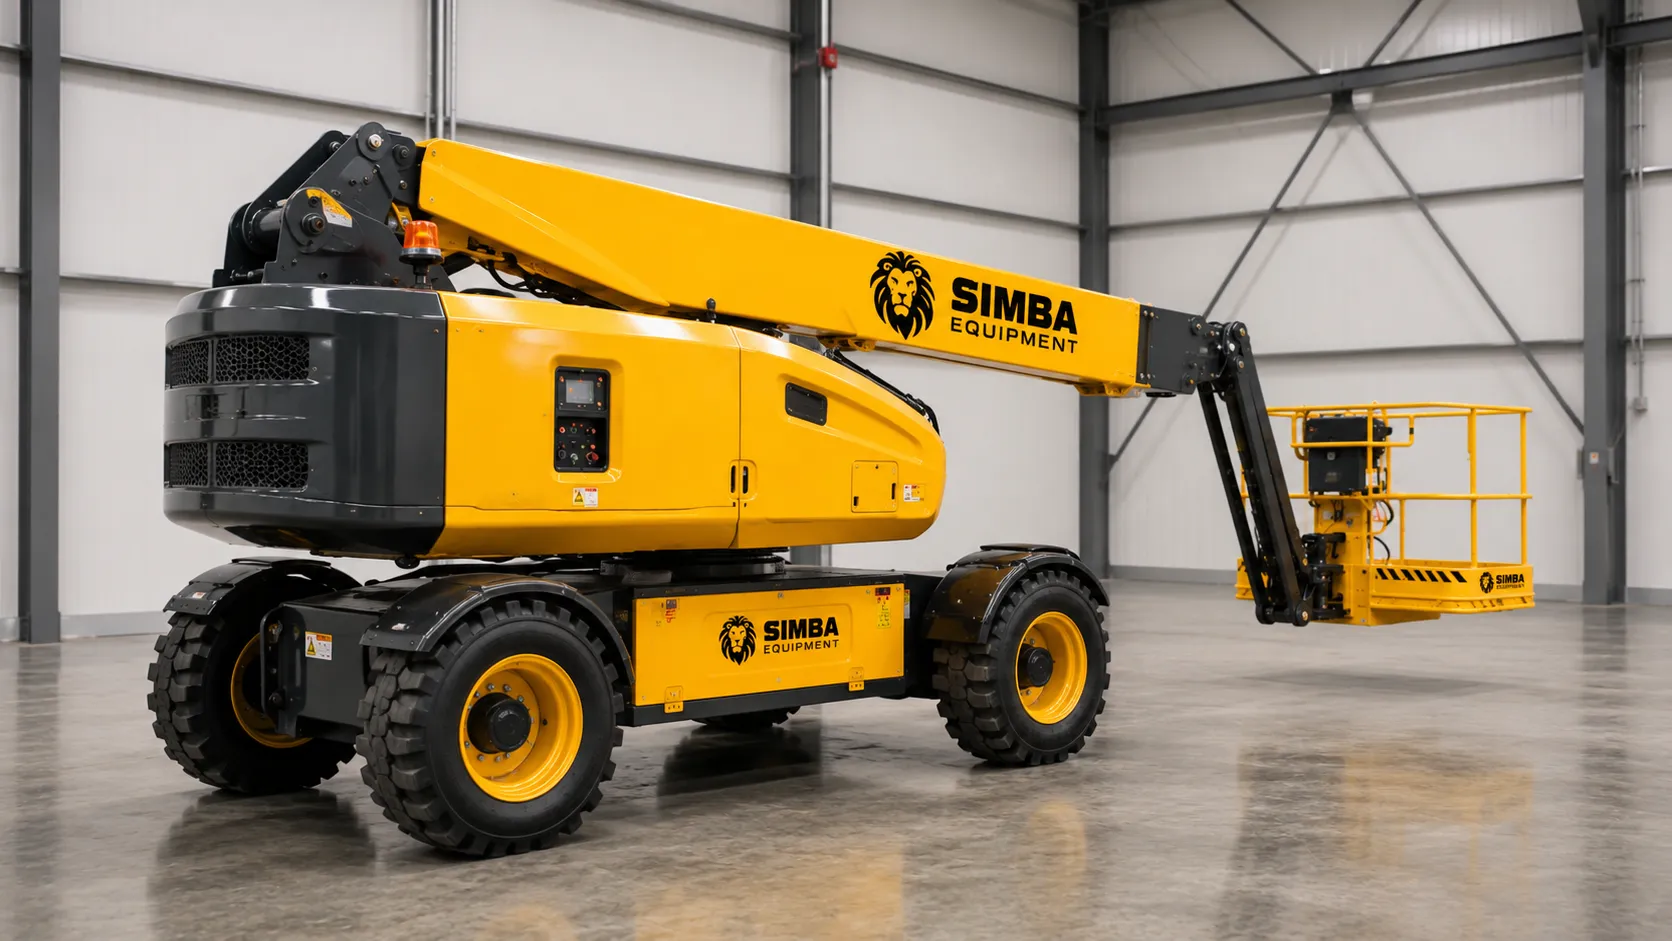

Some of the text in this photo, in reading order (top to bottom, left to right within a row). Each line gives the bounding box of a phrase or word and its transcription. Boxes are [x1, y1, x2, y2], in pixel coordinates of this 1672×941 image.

[951, 276, 1078, 335] SIMBA
[951, 316, 1078, 354] EQUIPMENT
[1495, 573, 1525, 584] SIMBA
[763, 616, 839, 642] SIMBA
[763, 639, 839, 654] EQUIPMENT
